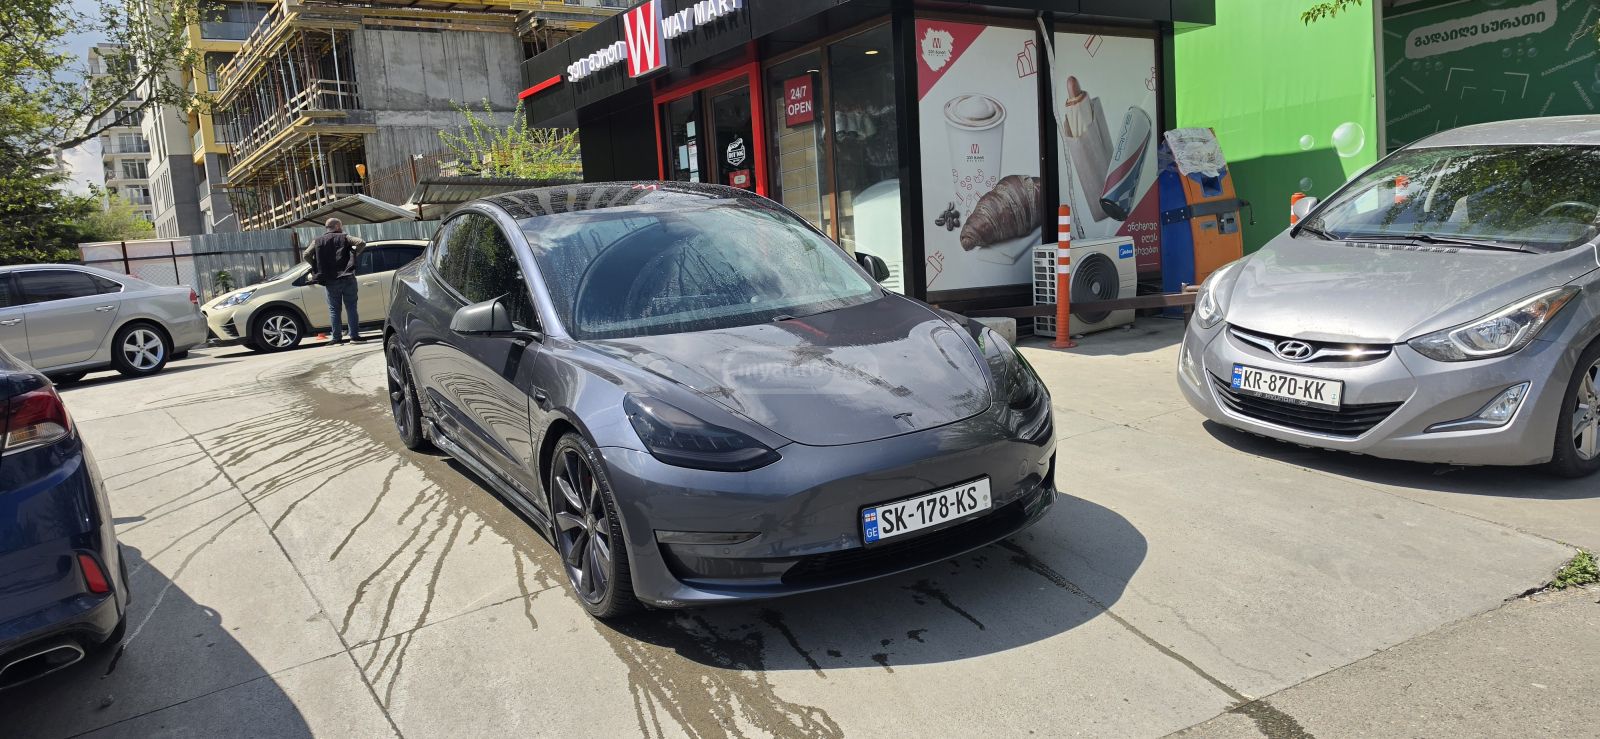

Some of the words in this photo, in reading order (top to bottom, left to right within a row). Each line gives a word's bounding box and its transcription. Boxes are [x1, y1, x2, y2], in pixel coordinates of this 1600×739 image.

[623, 0, 656, 76] W
[661, 7, 693, 39] WAY
[1414, 25, 1478, 47] გადაიღე
[1481, 11, 1546, 34] სურათი
[787, 100, 812, 115] OPEN
[790, 85, 807, 99] 24/7
[1233, 377, 1240, 386] GE
[1243, 369, 1326, 401] KR-870-KK
[881, 486, 978, 534] SK-178-KS
[866, 526, 878, 538] GE
